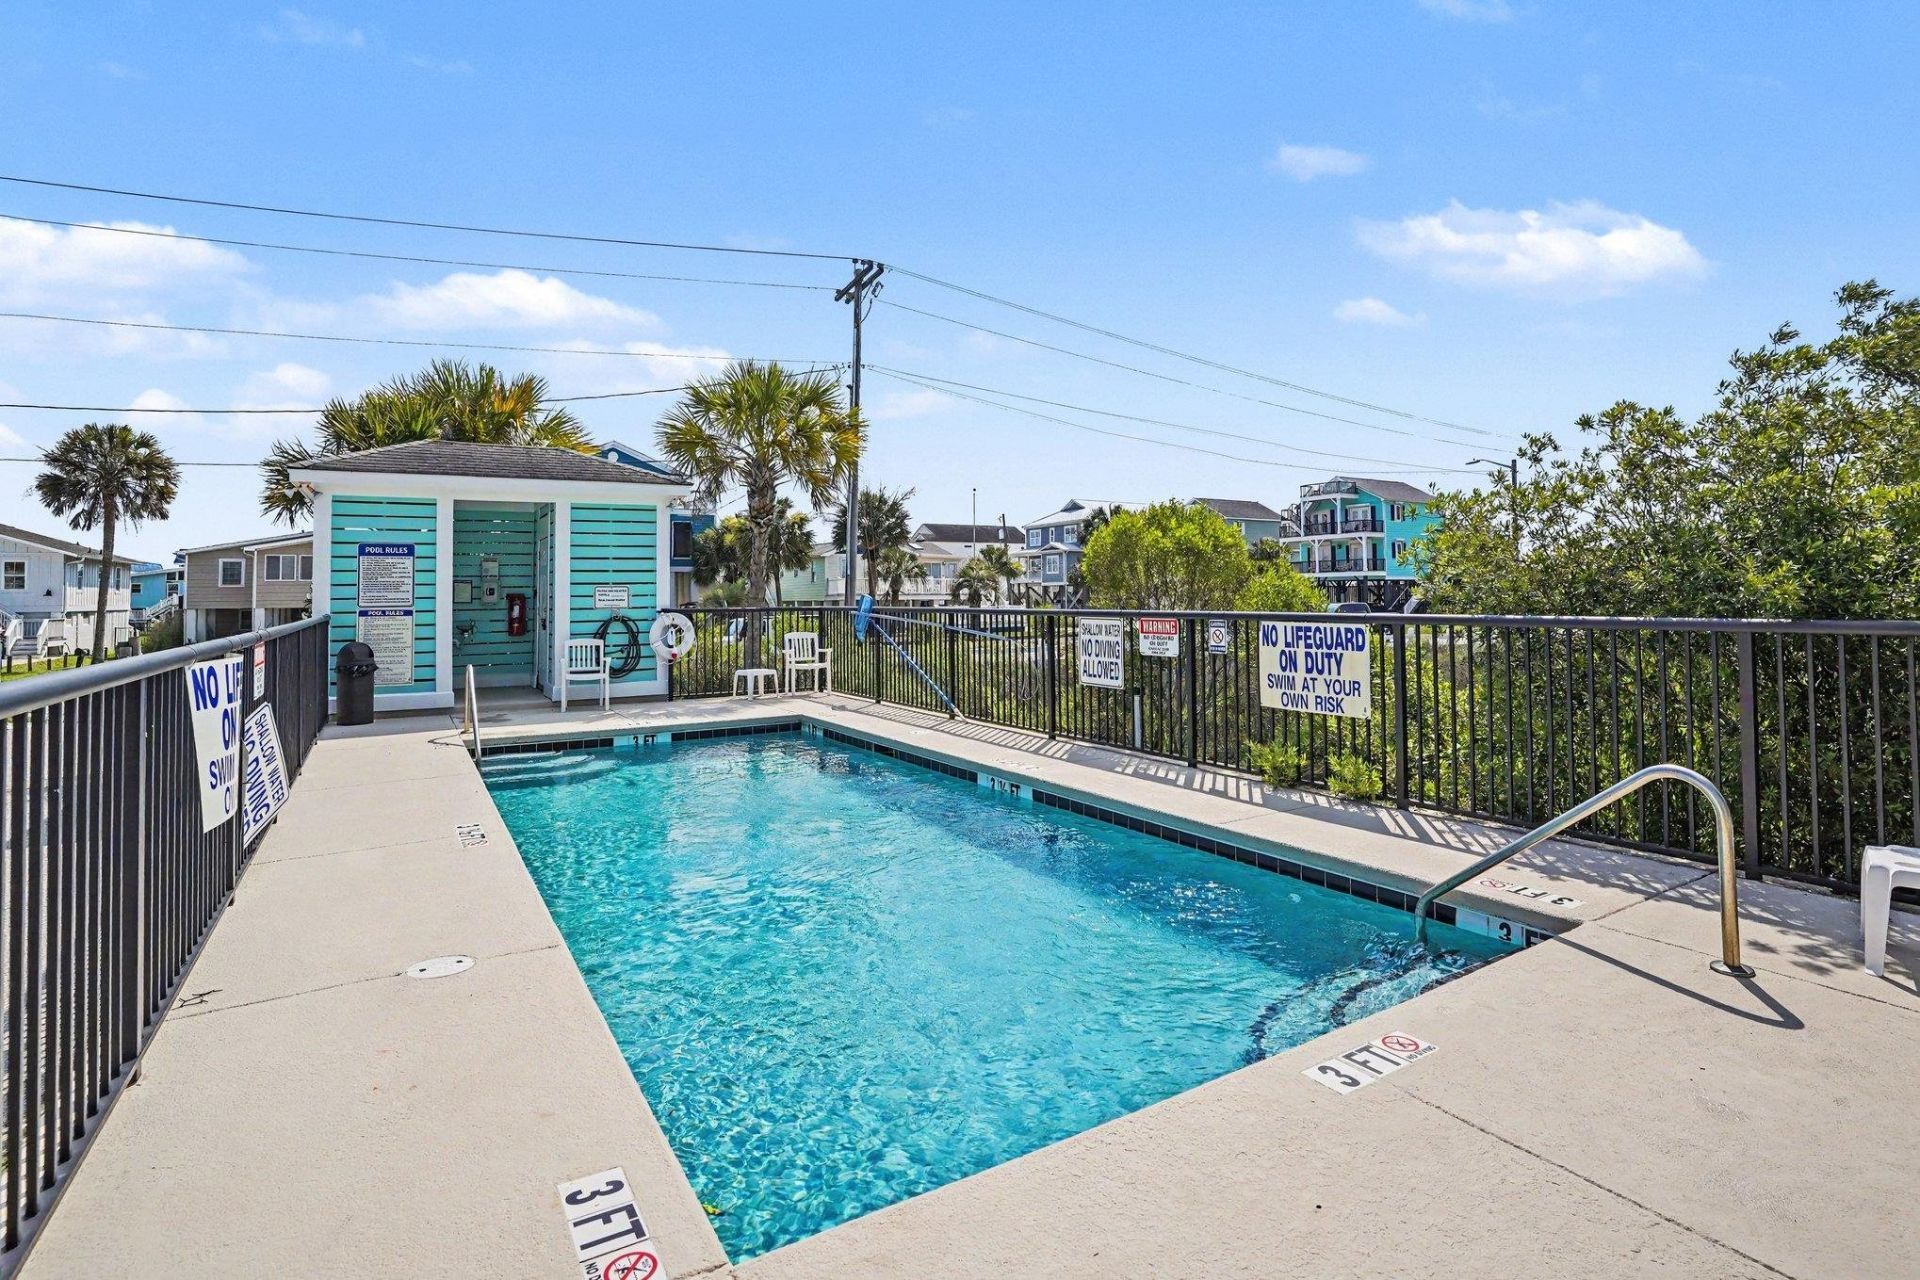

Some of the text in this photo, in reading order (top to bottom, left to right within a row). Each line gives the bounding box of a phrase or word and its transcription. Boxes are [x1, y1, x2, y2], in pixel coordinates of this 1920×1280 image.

[365, 546, 408, 554] POOL RULES
[1082, 623, 1120, 637] SHALLOW WATER
[1142, 620, 1176, 634] WARNING
[1262, 624, 1366, 652] NO LIFEGUARD
[1082, 639, 1120, 659] NO DIVING
[1083, 659, 1120, 680] ALLOWED
[1279, 649, 1344, 676] ON DUTY
[191, 666, 219, 711] NO
[1267, 673, 1361, 697] SWIM AT YOUR
[1281, 692, 1345, 713] OWN RISK
[222, 706, 237, 751] ON
[255, 714, 276, 767] SHALLOW
[268, 764, 285, 807] WATER
[246, 756, 271, 826] DIVING
[1506, 886, 1574, 905] 3 FT
[1498, 922, 1512, 942] 3
[1317, 1044, 1402, 1088] 3 FT
[565, 1180, 646, 1251] 3 FT
[585, 1262, 599, 1275] NO
